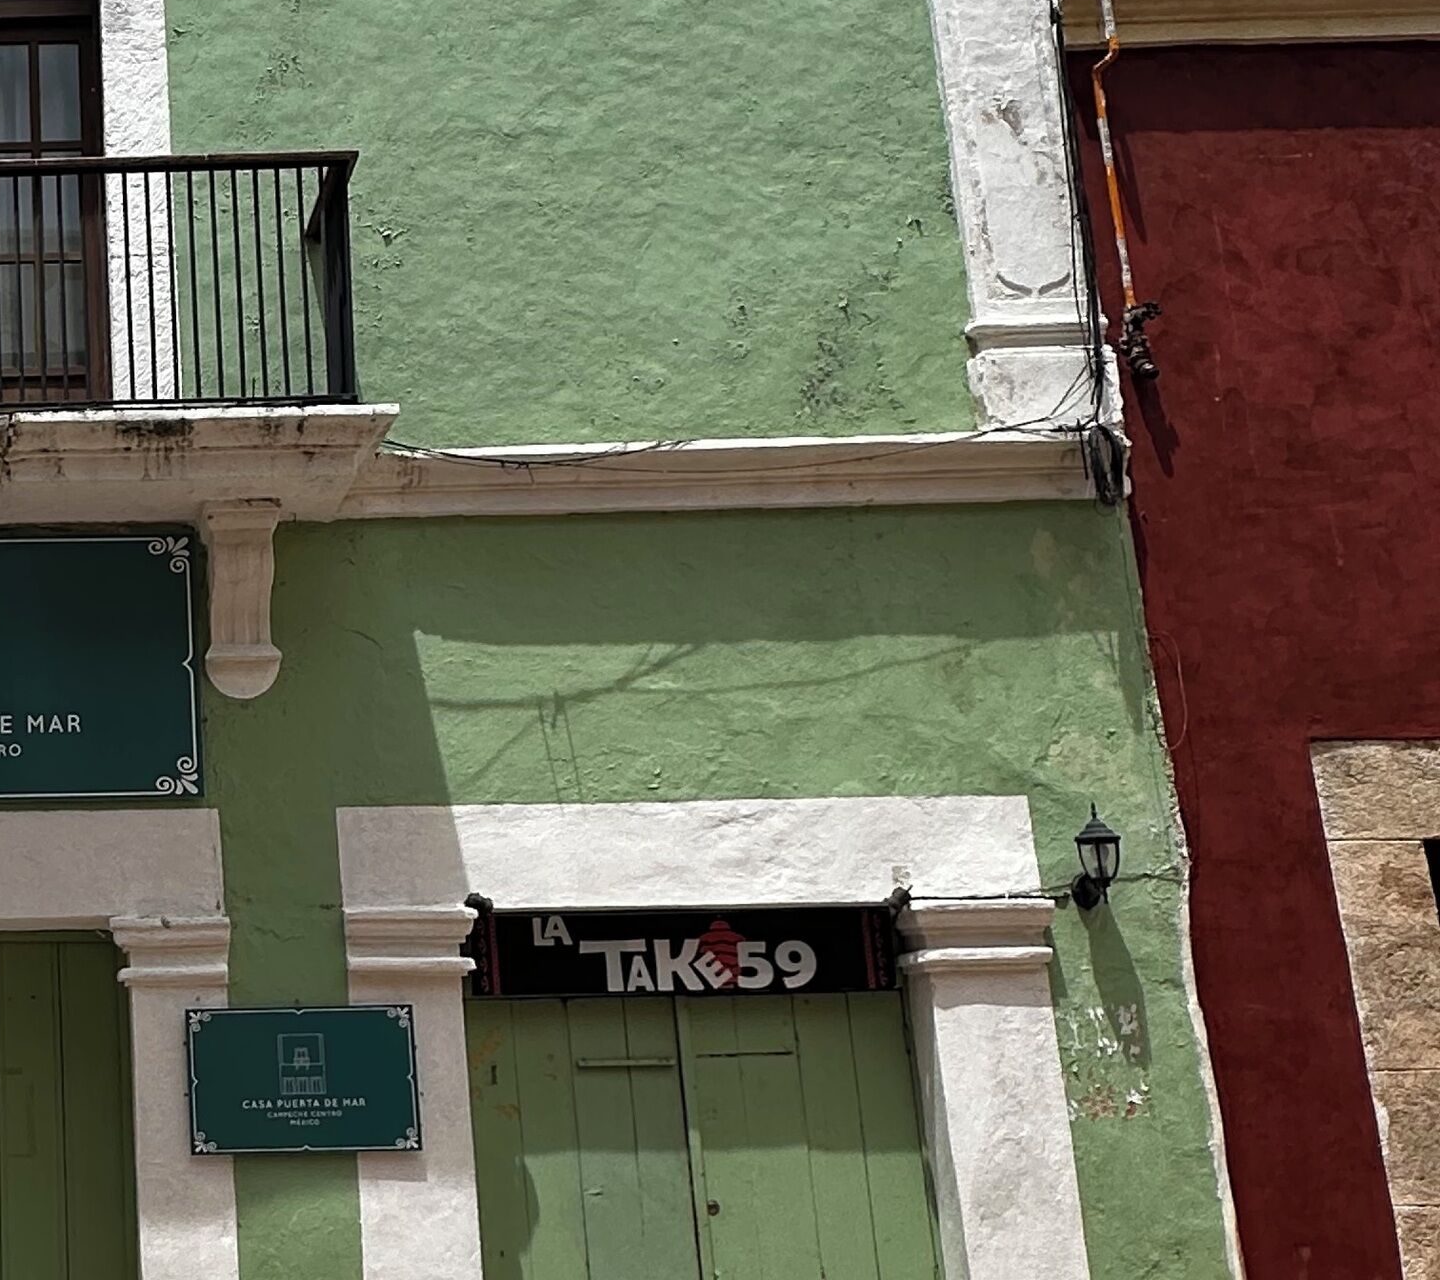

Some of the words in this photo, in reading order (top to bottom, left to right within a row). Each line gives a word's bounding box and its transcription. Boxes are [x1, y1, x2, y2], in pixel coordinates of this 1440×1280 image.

[27, 714, 81, 733] MAR
[532, 915, 573, 946] LA
[242, 1100, 273, 1109] CASA
[277, 1098, 320, 1108] PUERTA
[324, 1098, 339, 1107] DE
[343, 1097, 366, 1107] MAR
